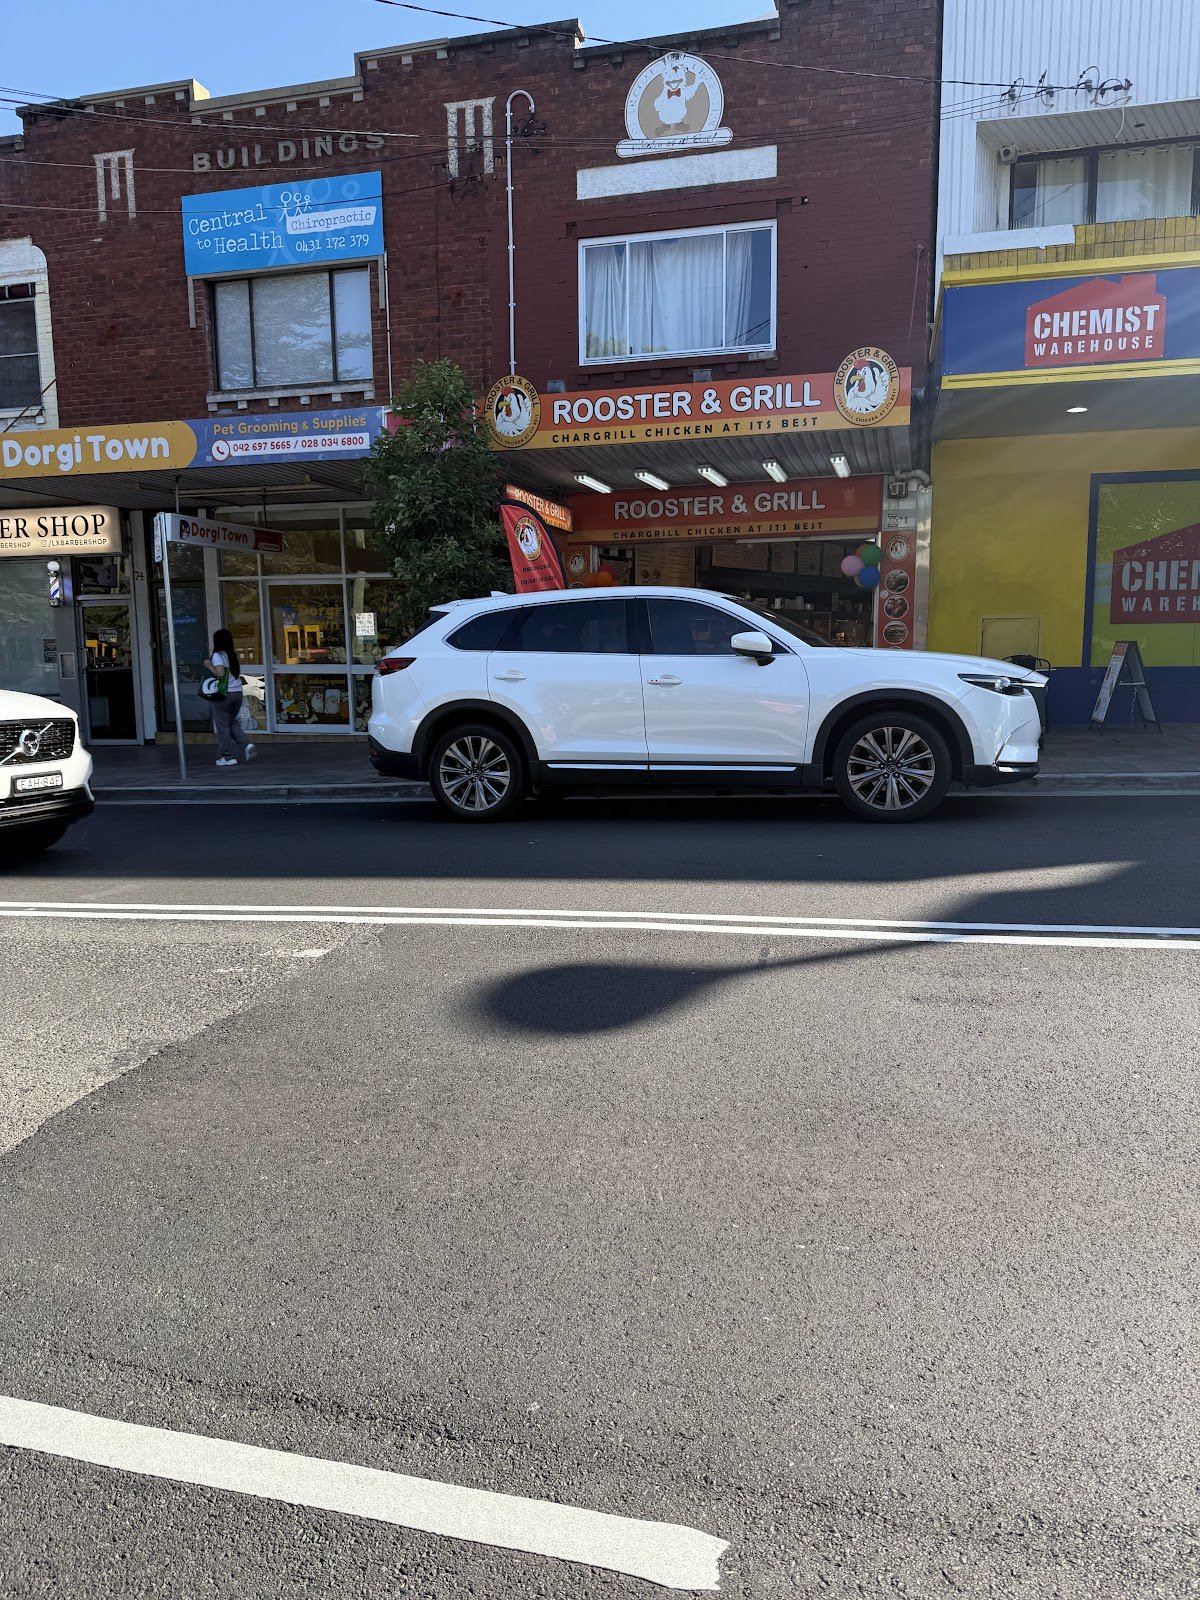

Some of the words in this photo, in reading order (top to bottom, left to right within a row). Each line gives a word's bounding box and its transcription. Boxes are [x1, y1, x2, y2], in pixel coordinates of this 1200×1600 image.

[192, 130, 385, 173] BUILDINGS
[189, 204, 268, 235] Central
[291, 210, 372, 231] Chiropractic
[197, 238, 211, 250] to
[214, 230, 284, 254] Health
[295, 240, 322, 254] 0431
[326, 236, 346, 248] 172
[349, 234, 369, 247] 379
[1034, 304, 1160, 339] CHEMIST
[1034, 335, 1153, 356] WAREHOUSE
[836, 348, 871, 385] ROOSTER
[873, 349, 880, 358] &
[881, 354, 899, 382] GRILL
[486, 376, 515, 410] ROOSTER
[516, 377, 523, 385] &
[524, 382, 540, 408] GRILL
[552, 391, 693, 425] ROOSTER
[700, 388, 722, 415] &
[729, 381, 822, 412] GRILL
[213, 424, 234, 435] Pet
[238, 419, 298, 434] Grooming
[302, 422, 309, 430] &
[312, 416, 367, 431] Supplies
[552, 430, 636, 443] CHARGRILL
[645, 424, 714, 438] CHICKEN
[722, 422, 741, 432] AT
[750, 420, 771, 431] ITS
[781, 417, 818, 428] BEST
[855, 415, 879, 423] CHICKEN
[2, 435, 82, 472] Dorgi
[86, 435, 170, 462] Town
[233, 442, 250, 452] 042
[252, 441, 268, 451] 697
[270, 440, 291, 450] 5665
[301, 439, 319, 449] 028
[321, 438, 338, 447] 034
[341, 436, 364, 446] 6800
[514, 488, 544, 512] ROOSTER
[550, 503, 566, 521] GRILL
[614, 495, 724, 520] ROOSTER
[730, 494, 748, 514] &
[754, 489, 825, 513] GRILL
[0, 518, 30, 539] ER
[37, 514, 105, 539] SHOP
[191, 522, 220, 543] Dorgi
[221, 527, 249, 544] Town
[613, 529, 680, 539] CHARGRILL
[687, 526, 741, 536] CHICKEN
[748, 525, 762, 533] AT
[769, 524, 787, 532] ITS
[794, 522, 823, 530] BEST
[0, 541, 32, 549] BERSHOP
[134, 571, 145, 581] 74
[330, 678, 345, 686] good
